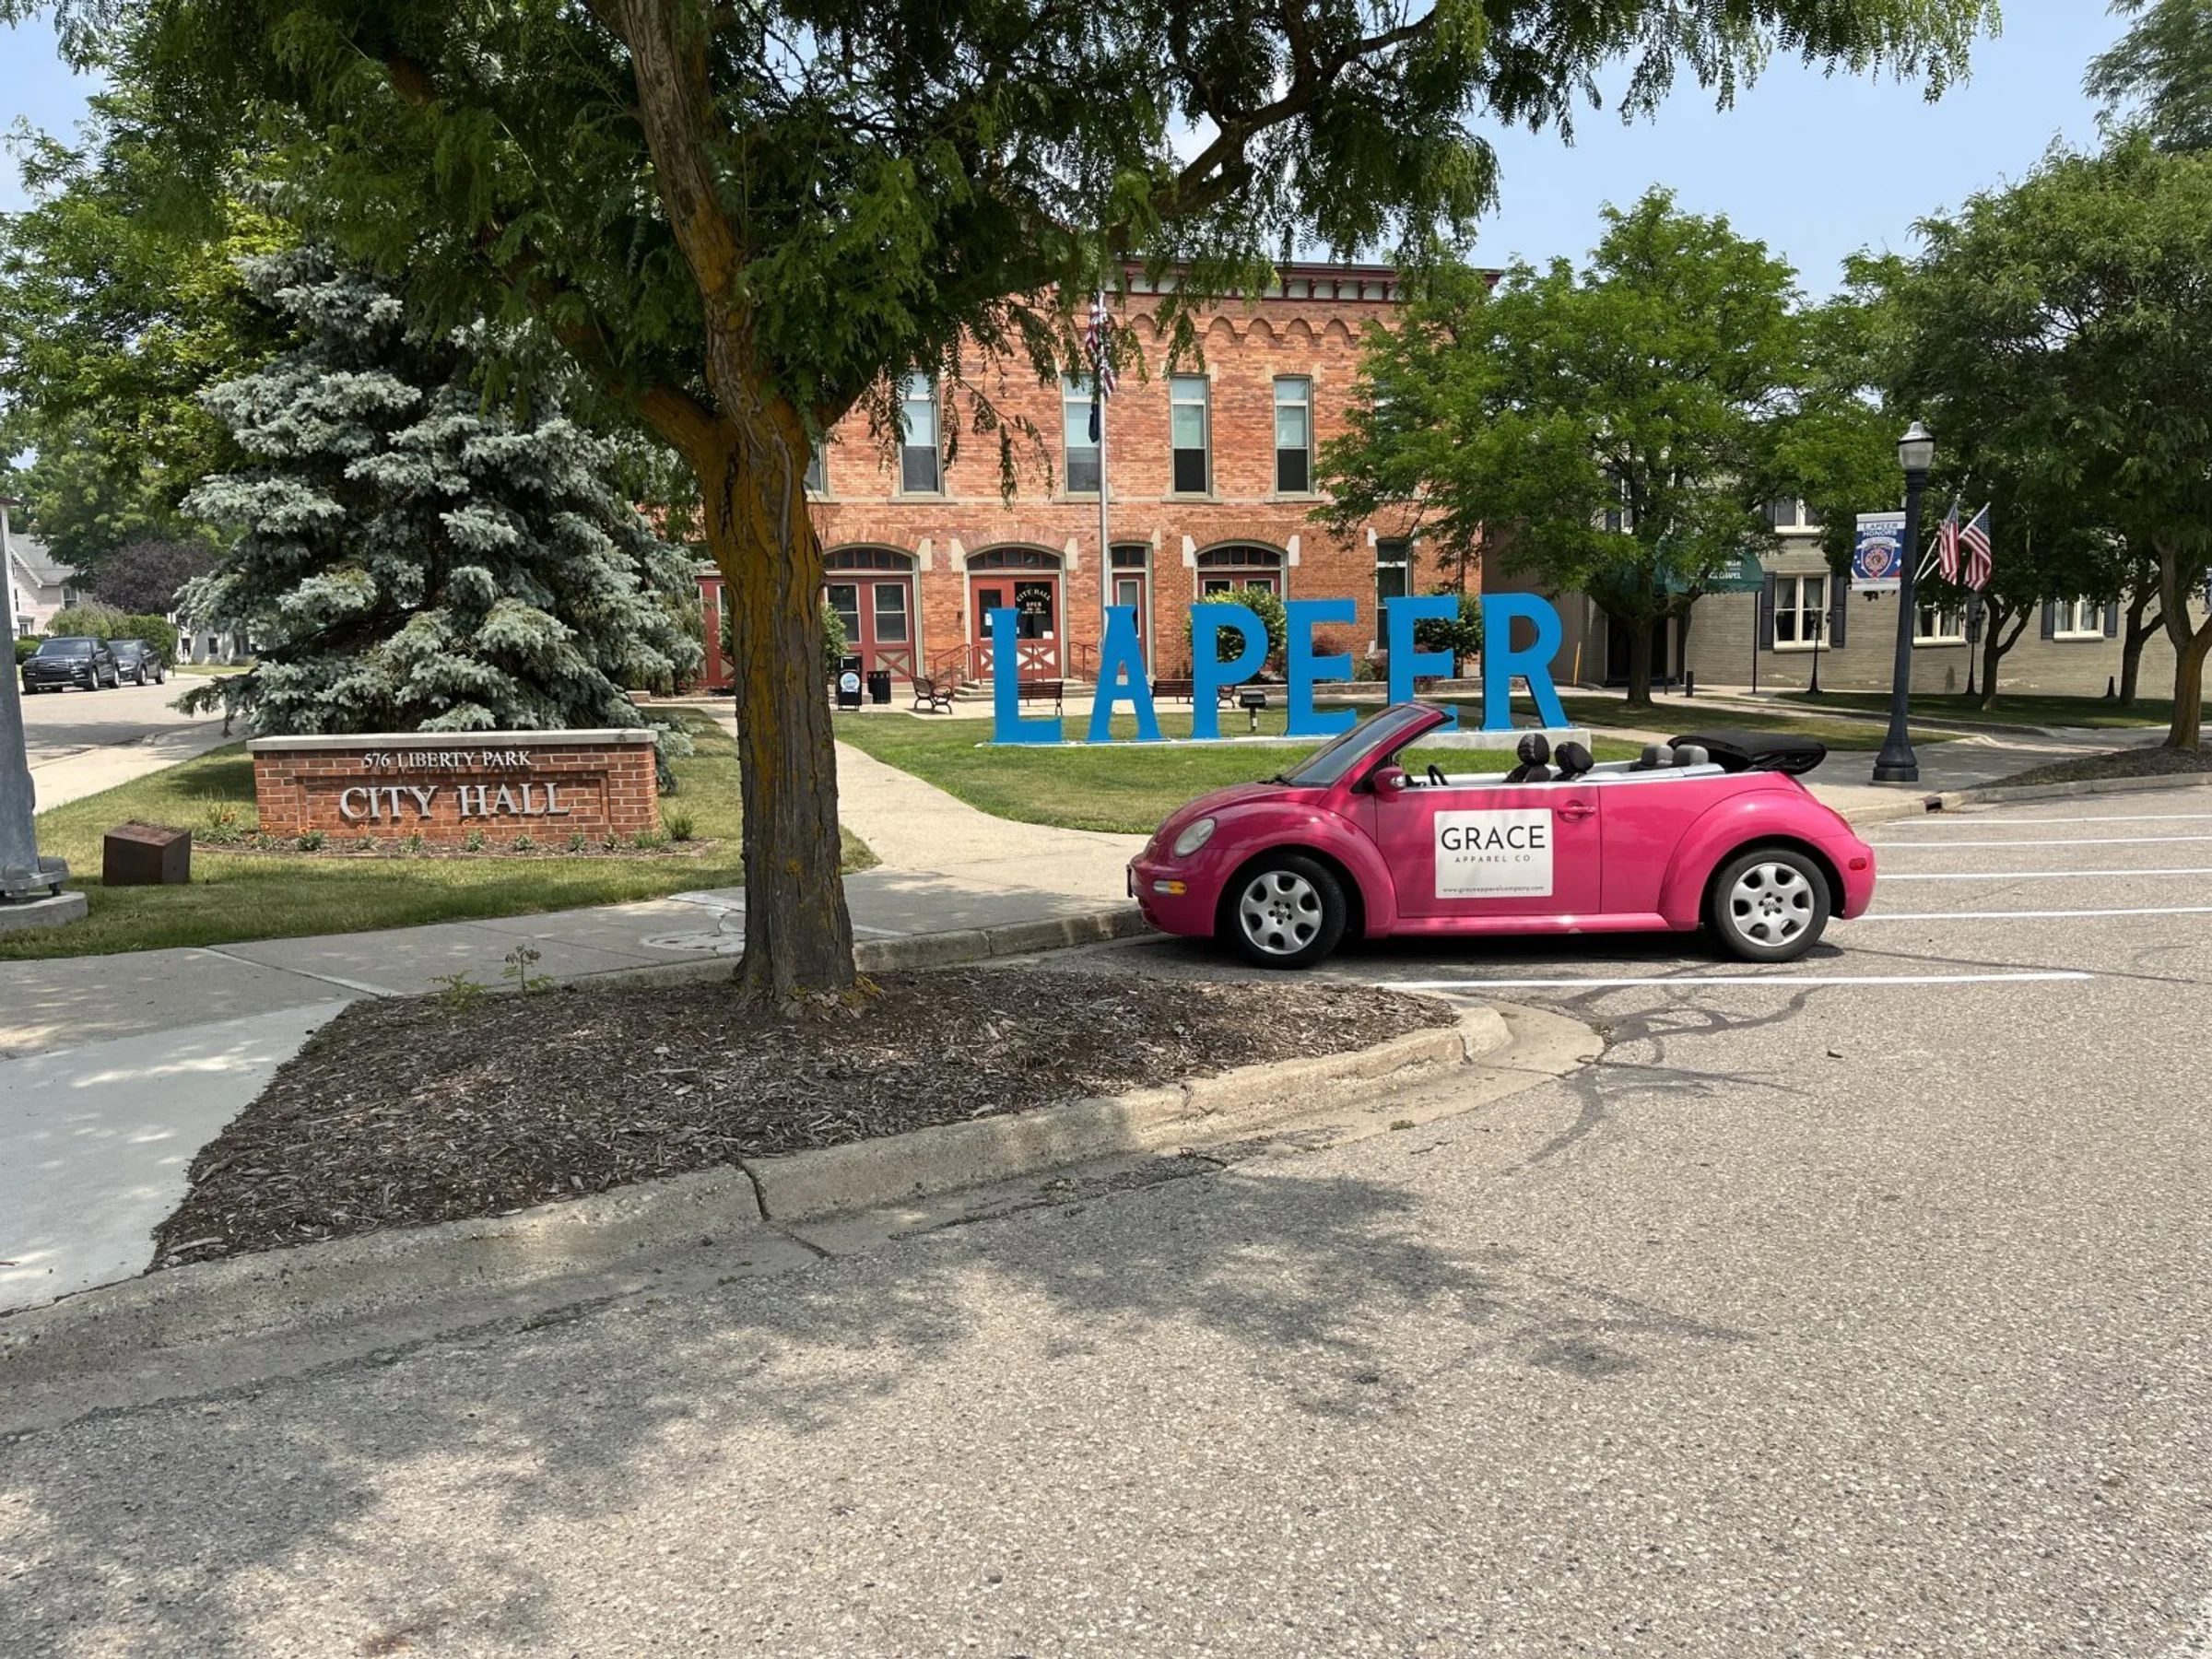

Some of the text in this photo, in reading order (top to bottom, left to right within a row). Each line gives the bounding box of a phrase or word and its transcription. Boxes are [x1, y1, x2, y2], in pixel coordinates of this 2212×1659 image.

[1016, 589, 1051, 602] CITY HALL
[988, 593, 1571, 744] LAPEER
[363, 750, 532, 768] 576 LIBERTY PARK
[339, 782, 571, 819] CITY HALL
[1441, 825, 1546, 851] GRACE
